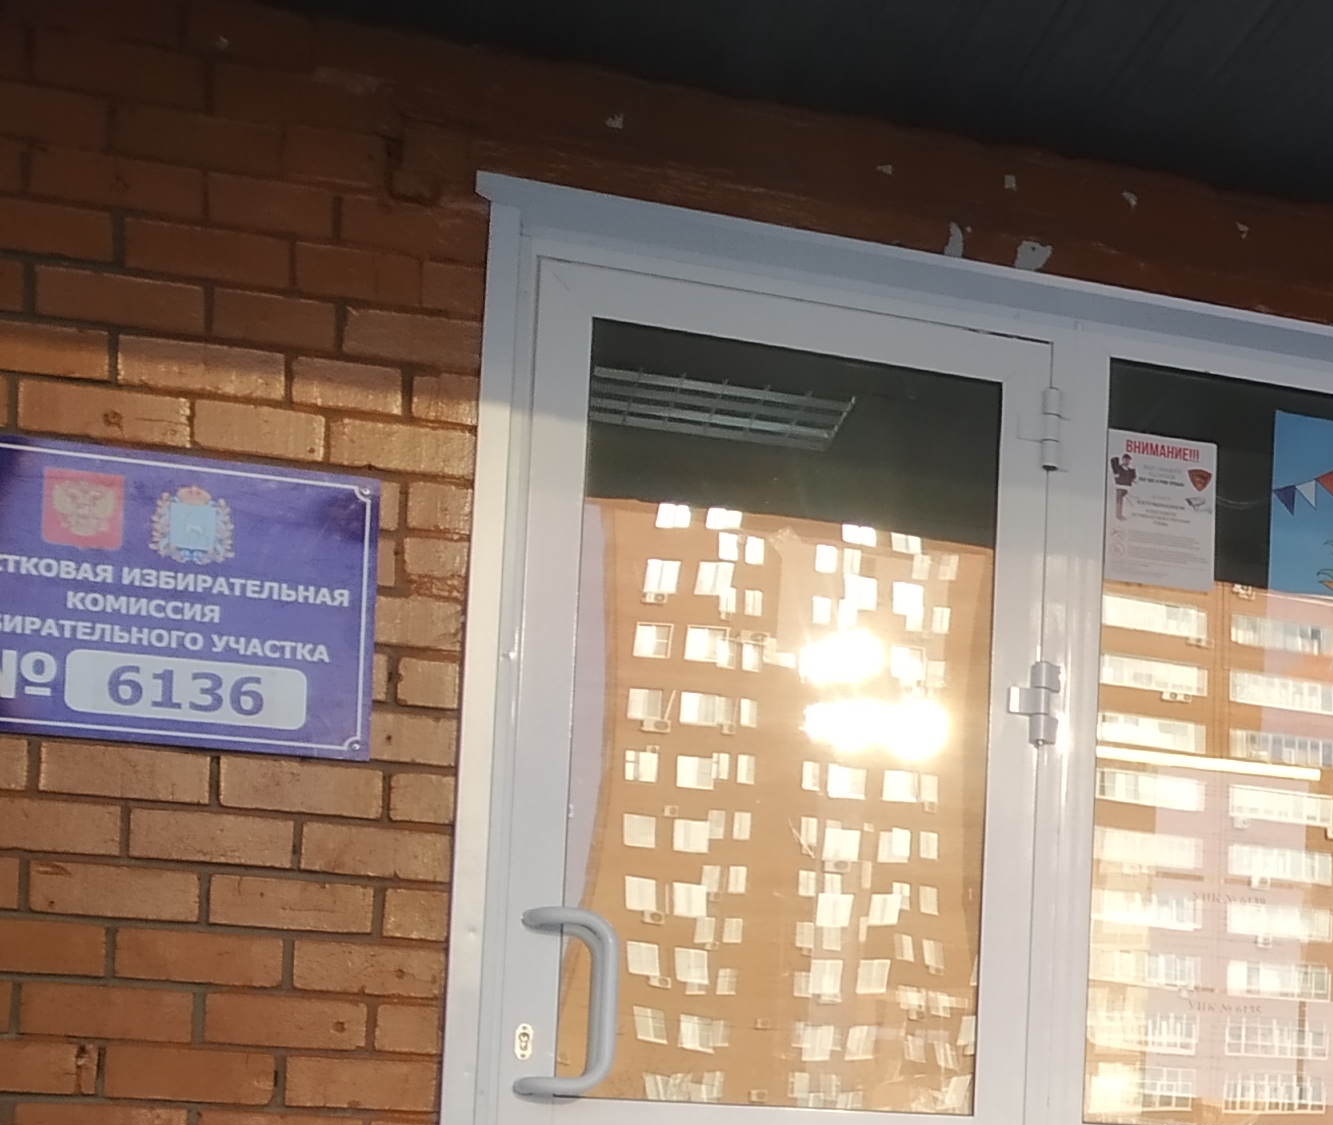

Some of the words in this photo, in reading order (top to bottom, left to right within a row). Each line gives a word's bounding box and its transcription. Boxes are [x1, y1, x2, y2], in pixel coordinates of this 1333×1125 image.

[1126, 439, 1200, 463] ВНИМАНИЕ!!!
[0, 554, 114, 583] ТКОВАЯ
[121, 567, 350, 607] ИЗБИРАТЕЛЬНАЯ
[66, 590, 220, 624] КОМИССИЯ
[0, 614, 204, 651] ИРАТЕЛЬНОГО
[211, 633, 330, 664] УЧАСТКА
[106, 664, 264, 717] 6136
